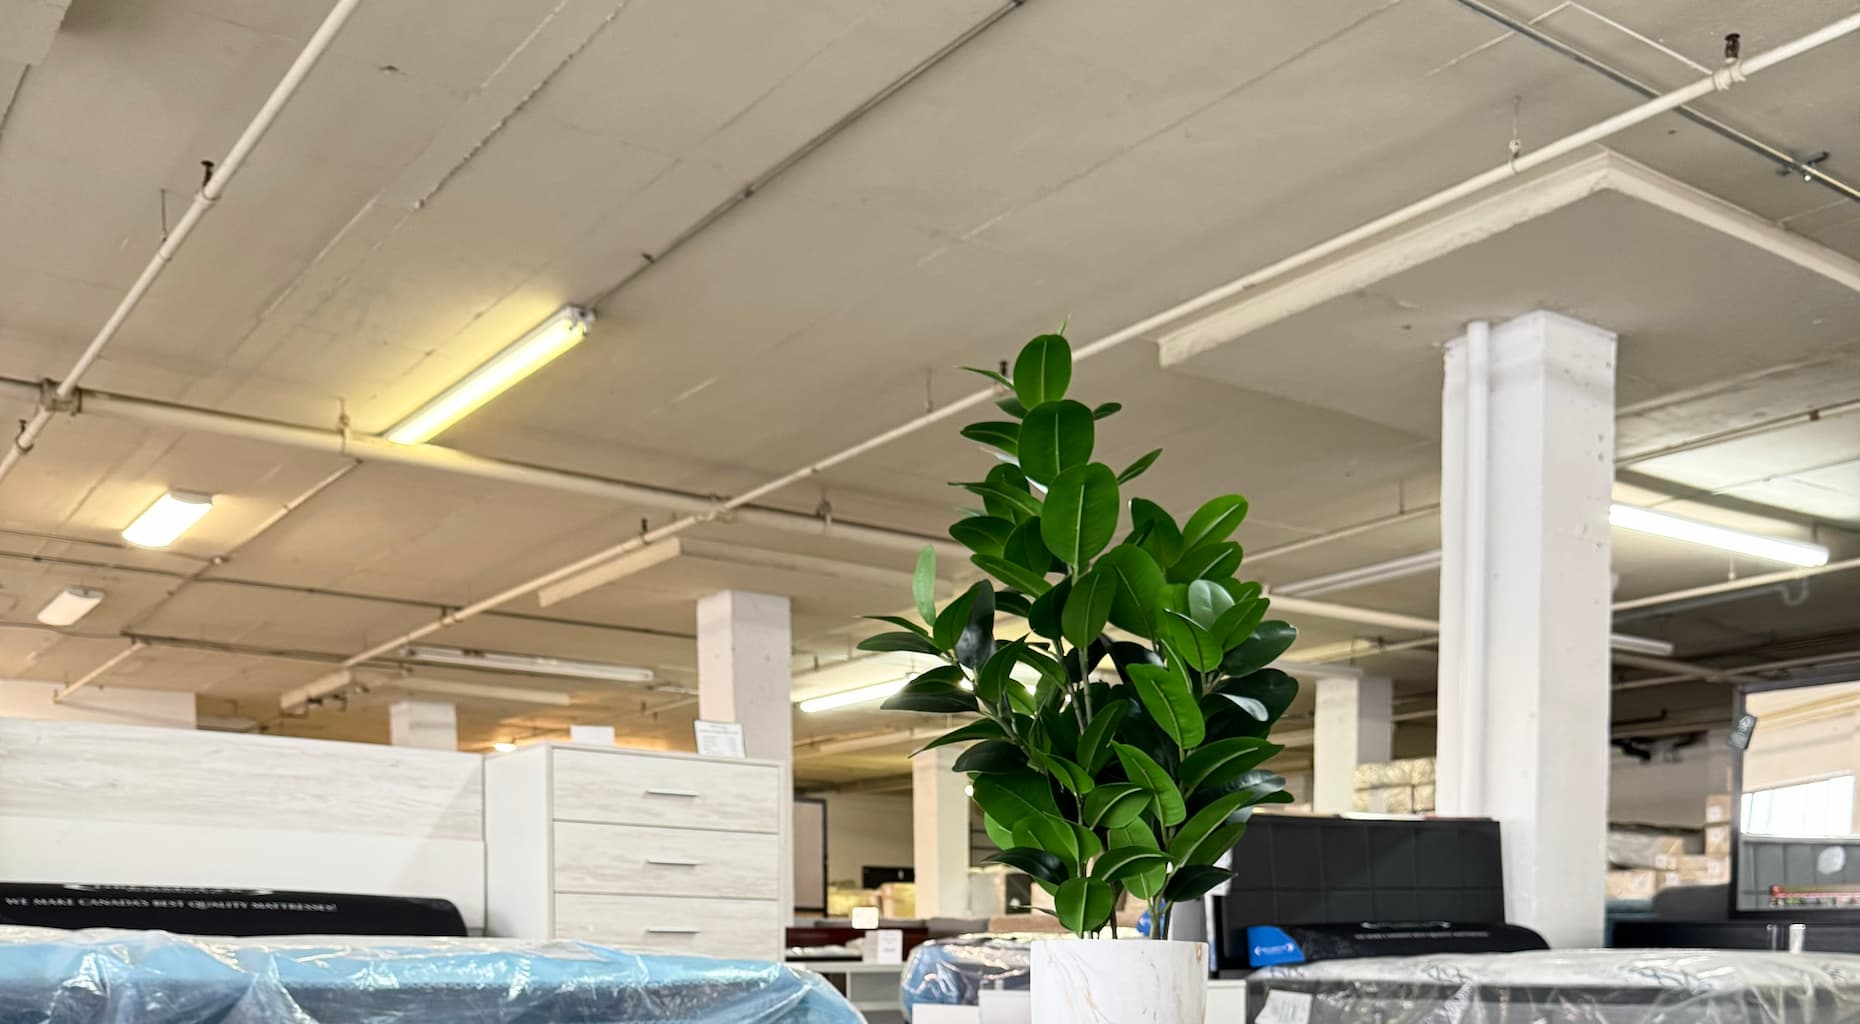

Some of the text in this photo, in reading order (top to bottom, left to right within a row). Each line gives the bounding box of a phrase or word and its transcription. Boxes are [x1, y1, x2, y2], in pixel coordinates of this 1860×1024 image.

[5, 897, 28, 906] WE
[33, 898, 75, 907] MAKE
[152, 899, 184, 909] BEST
[187, 900, 248, 911] QUALITY
